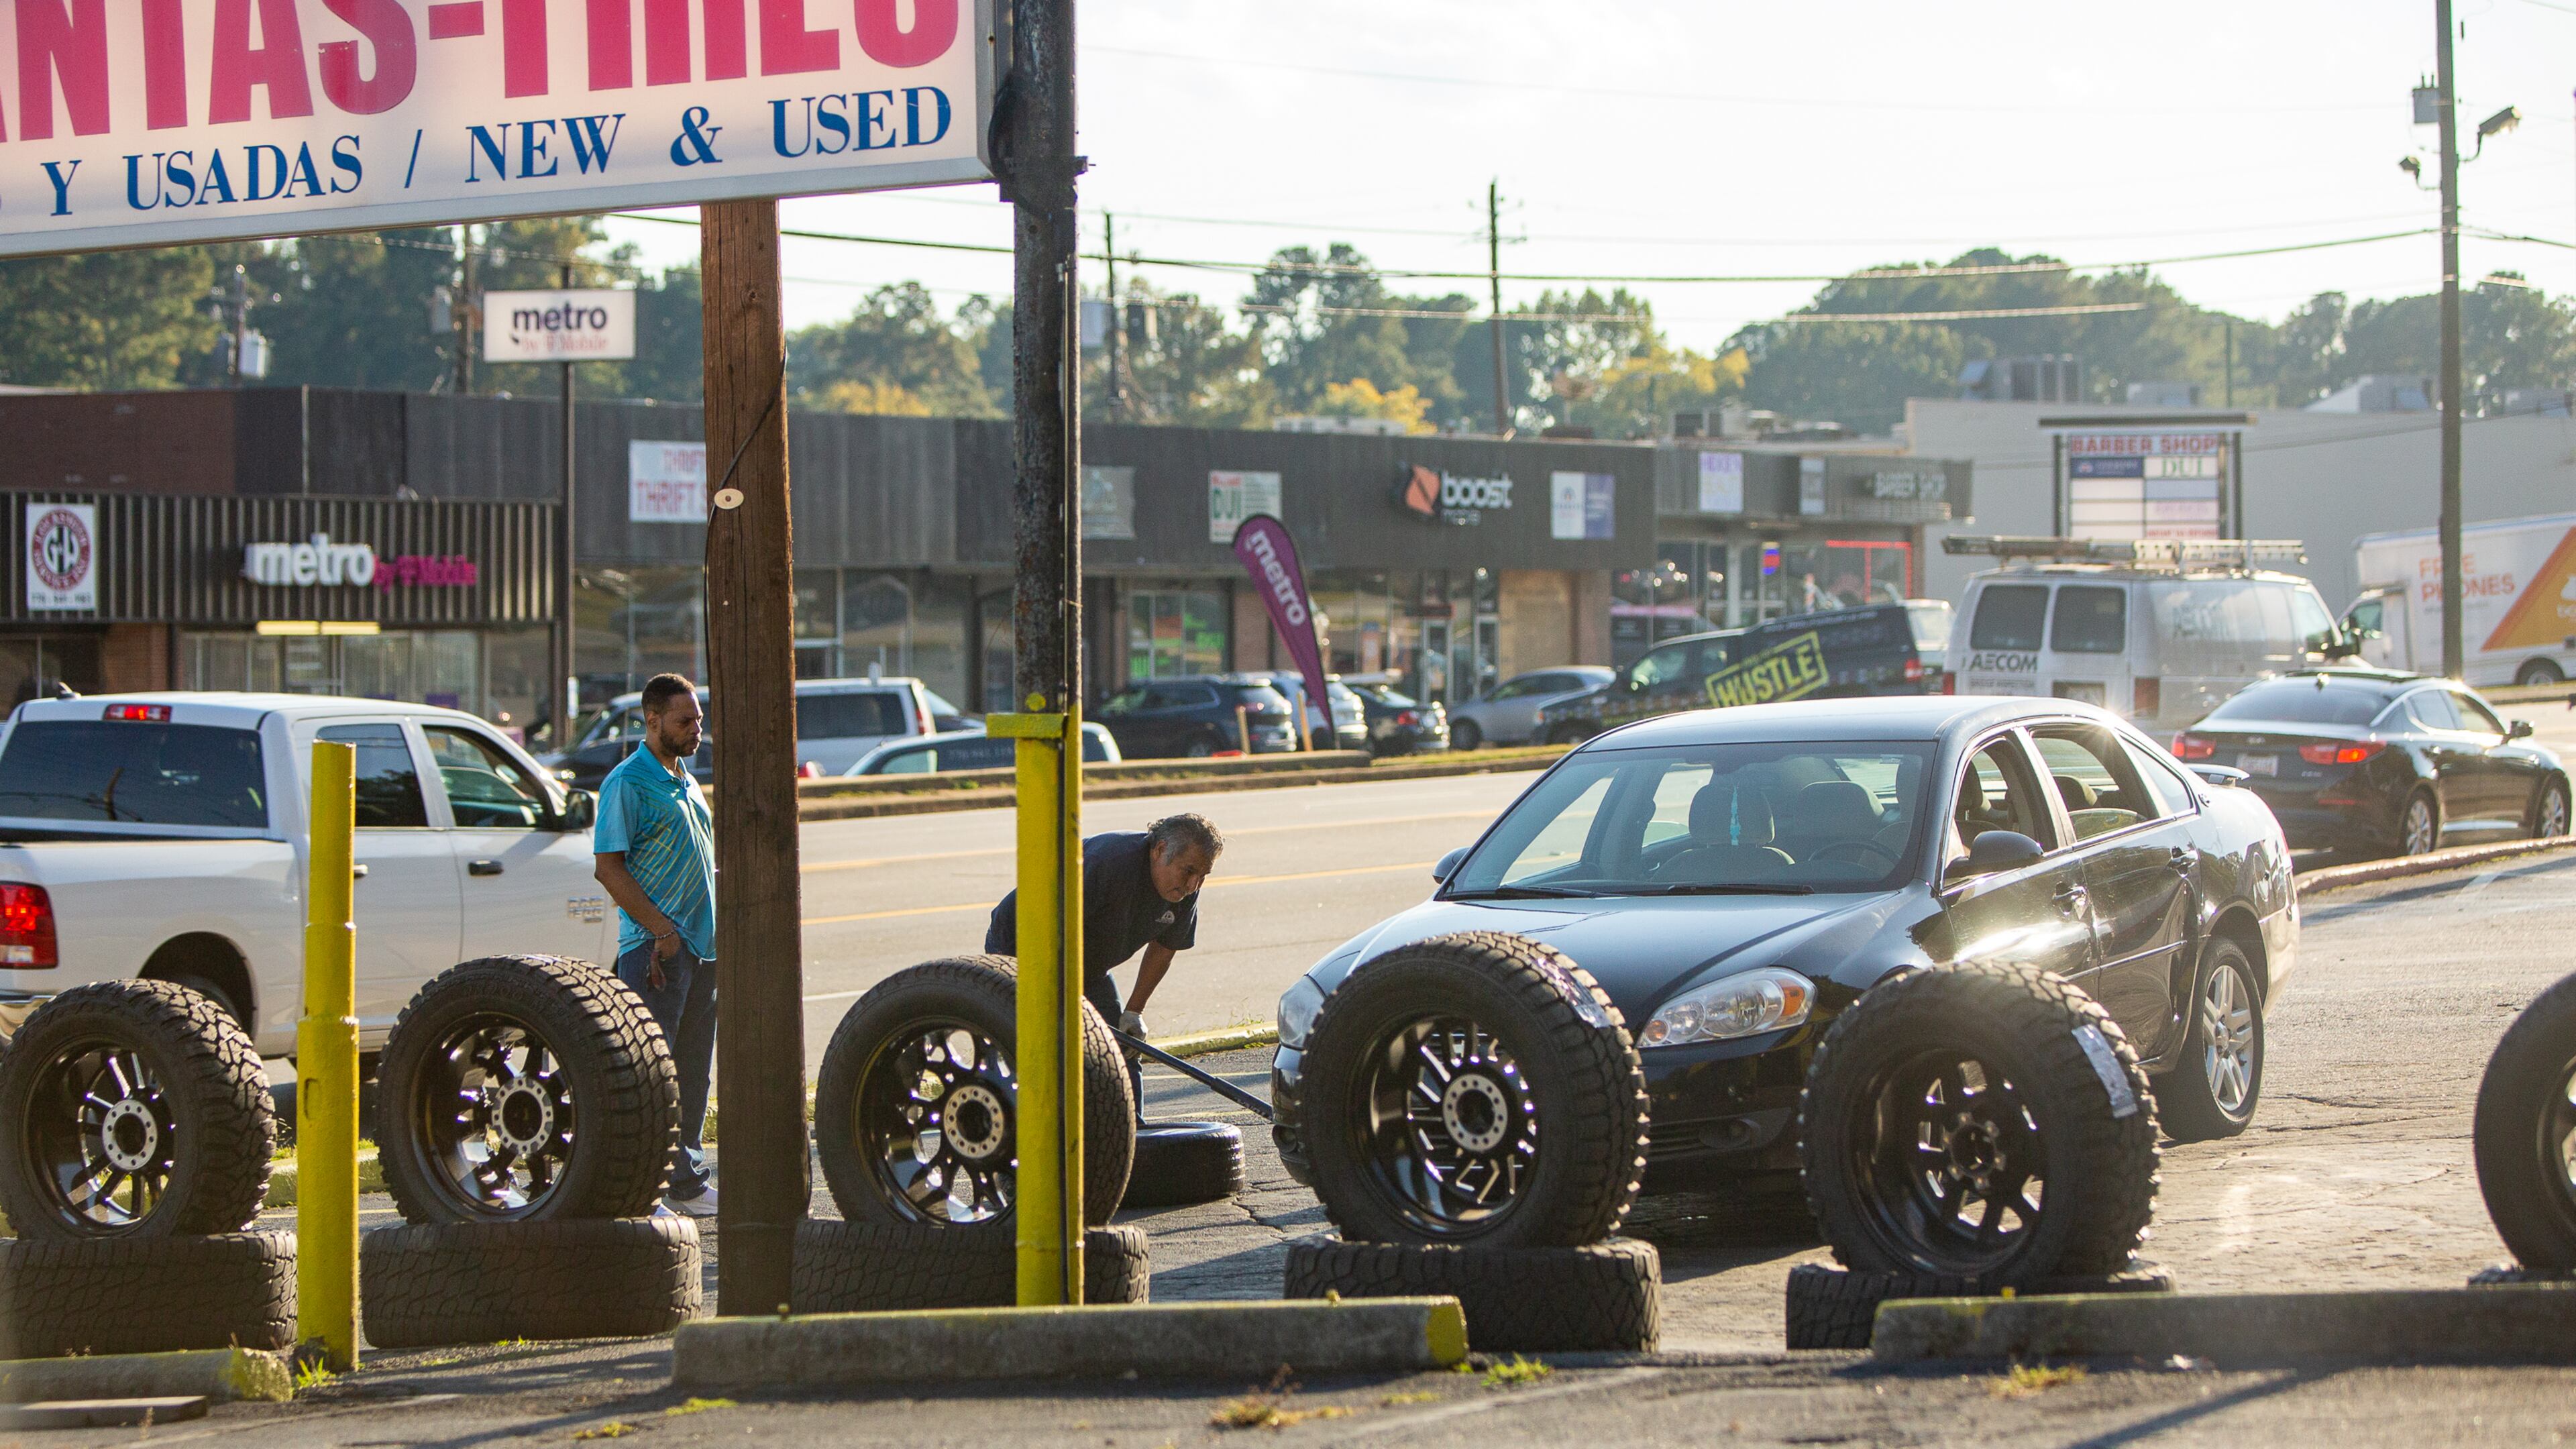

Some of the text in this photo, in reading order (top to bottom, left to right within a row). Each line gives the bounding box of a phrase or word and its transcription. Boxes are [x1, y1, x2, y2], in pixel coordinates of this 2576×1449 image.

[40, 160, 82, 217] Y
[123, 136, 362, 211] USADAS
[465, 113, 626, 183] NEW
[670, 106, 722, 166] &
[767, 86, 951, 158] USED
[513, 301, 607, 331] metro
[2072, 436, 2218, 453] BARBER SHOP
[2162, 458, 2202, 478] DUI
[1441, 470, 1513, 508] boost
[244, 533, 374, 586] metro
[2419, 553, 2476, 580] FRE
[1248, 529, 1306, 627] metro
[1716, 643, 1817, 706] HUSTLE
[1970, 654, 2038, 672] AECOM
